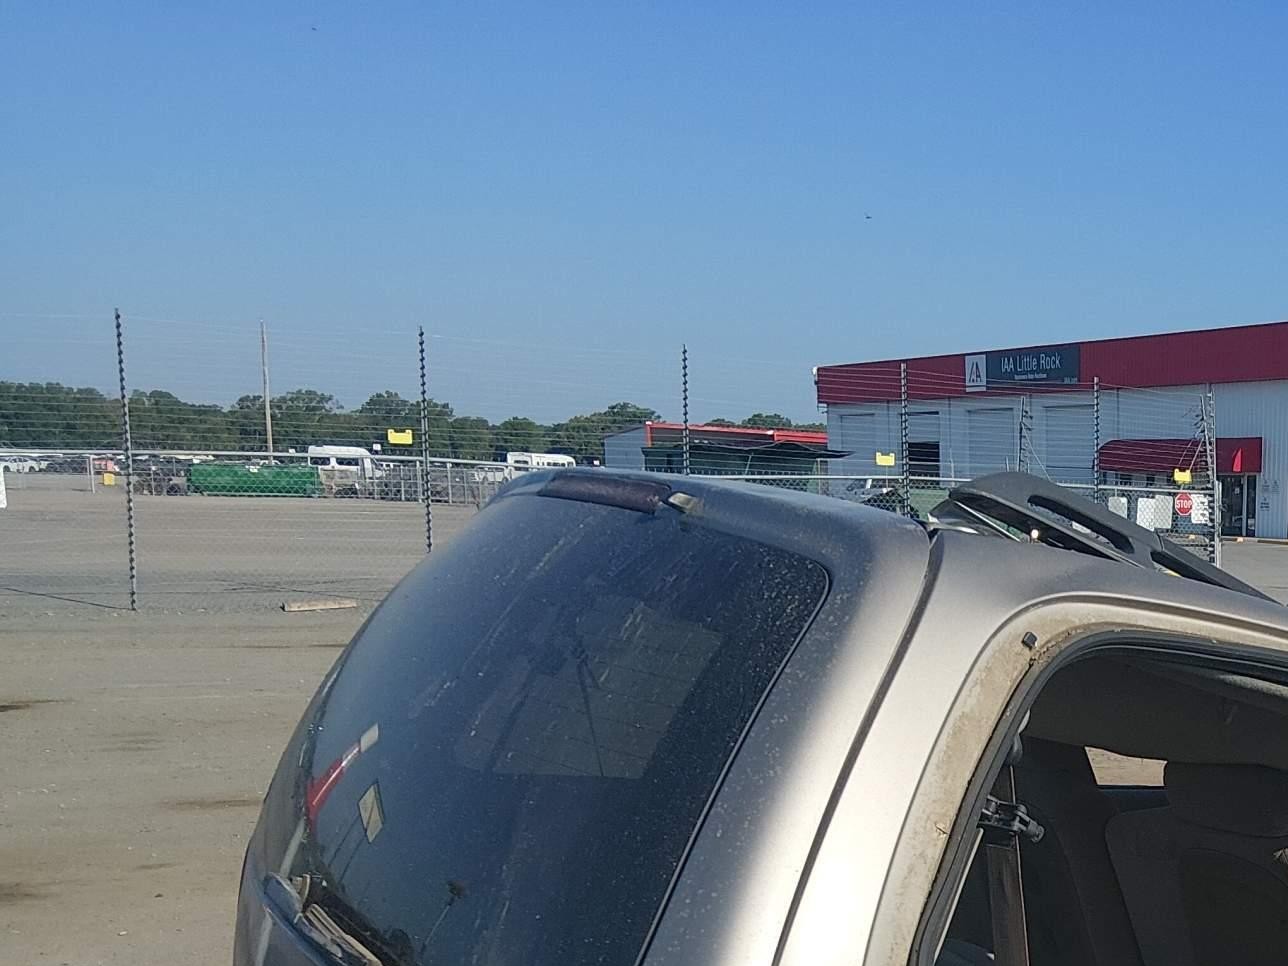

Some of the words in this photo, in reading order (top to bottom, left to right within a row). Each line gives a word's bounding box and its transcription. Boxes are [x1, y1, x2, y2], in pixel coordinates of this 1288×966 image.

[1001, 357, 1015, 373] IAA
[1016, 354, 1038, 372] Little
[1039, 351, 1062, 370] Rock
[1175, 500, 1192, 509] STOP
